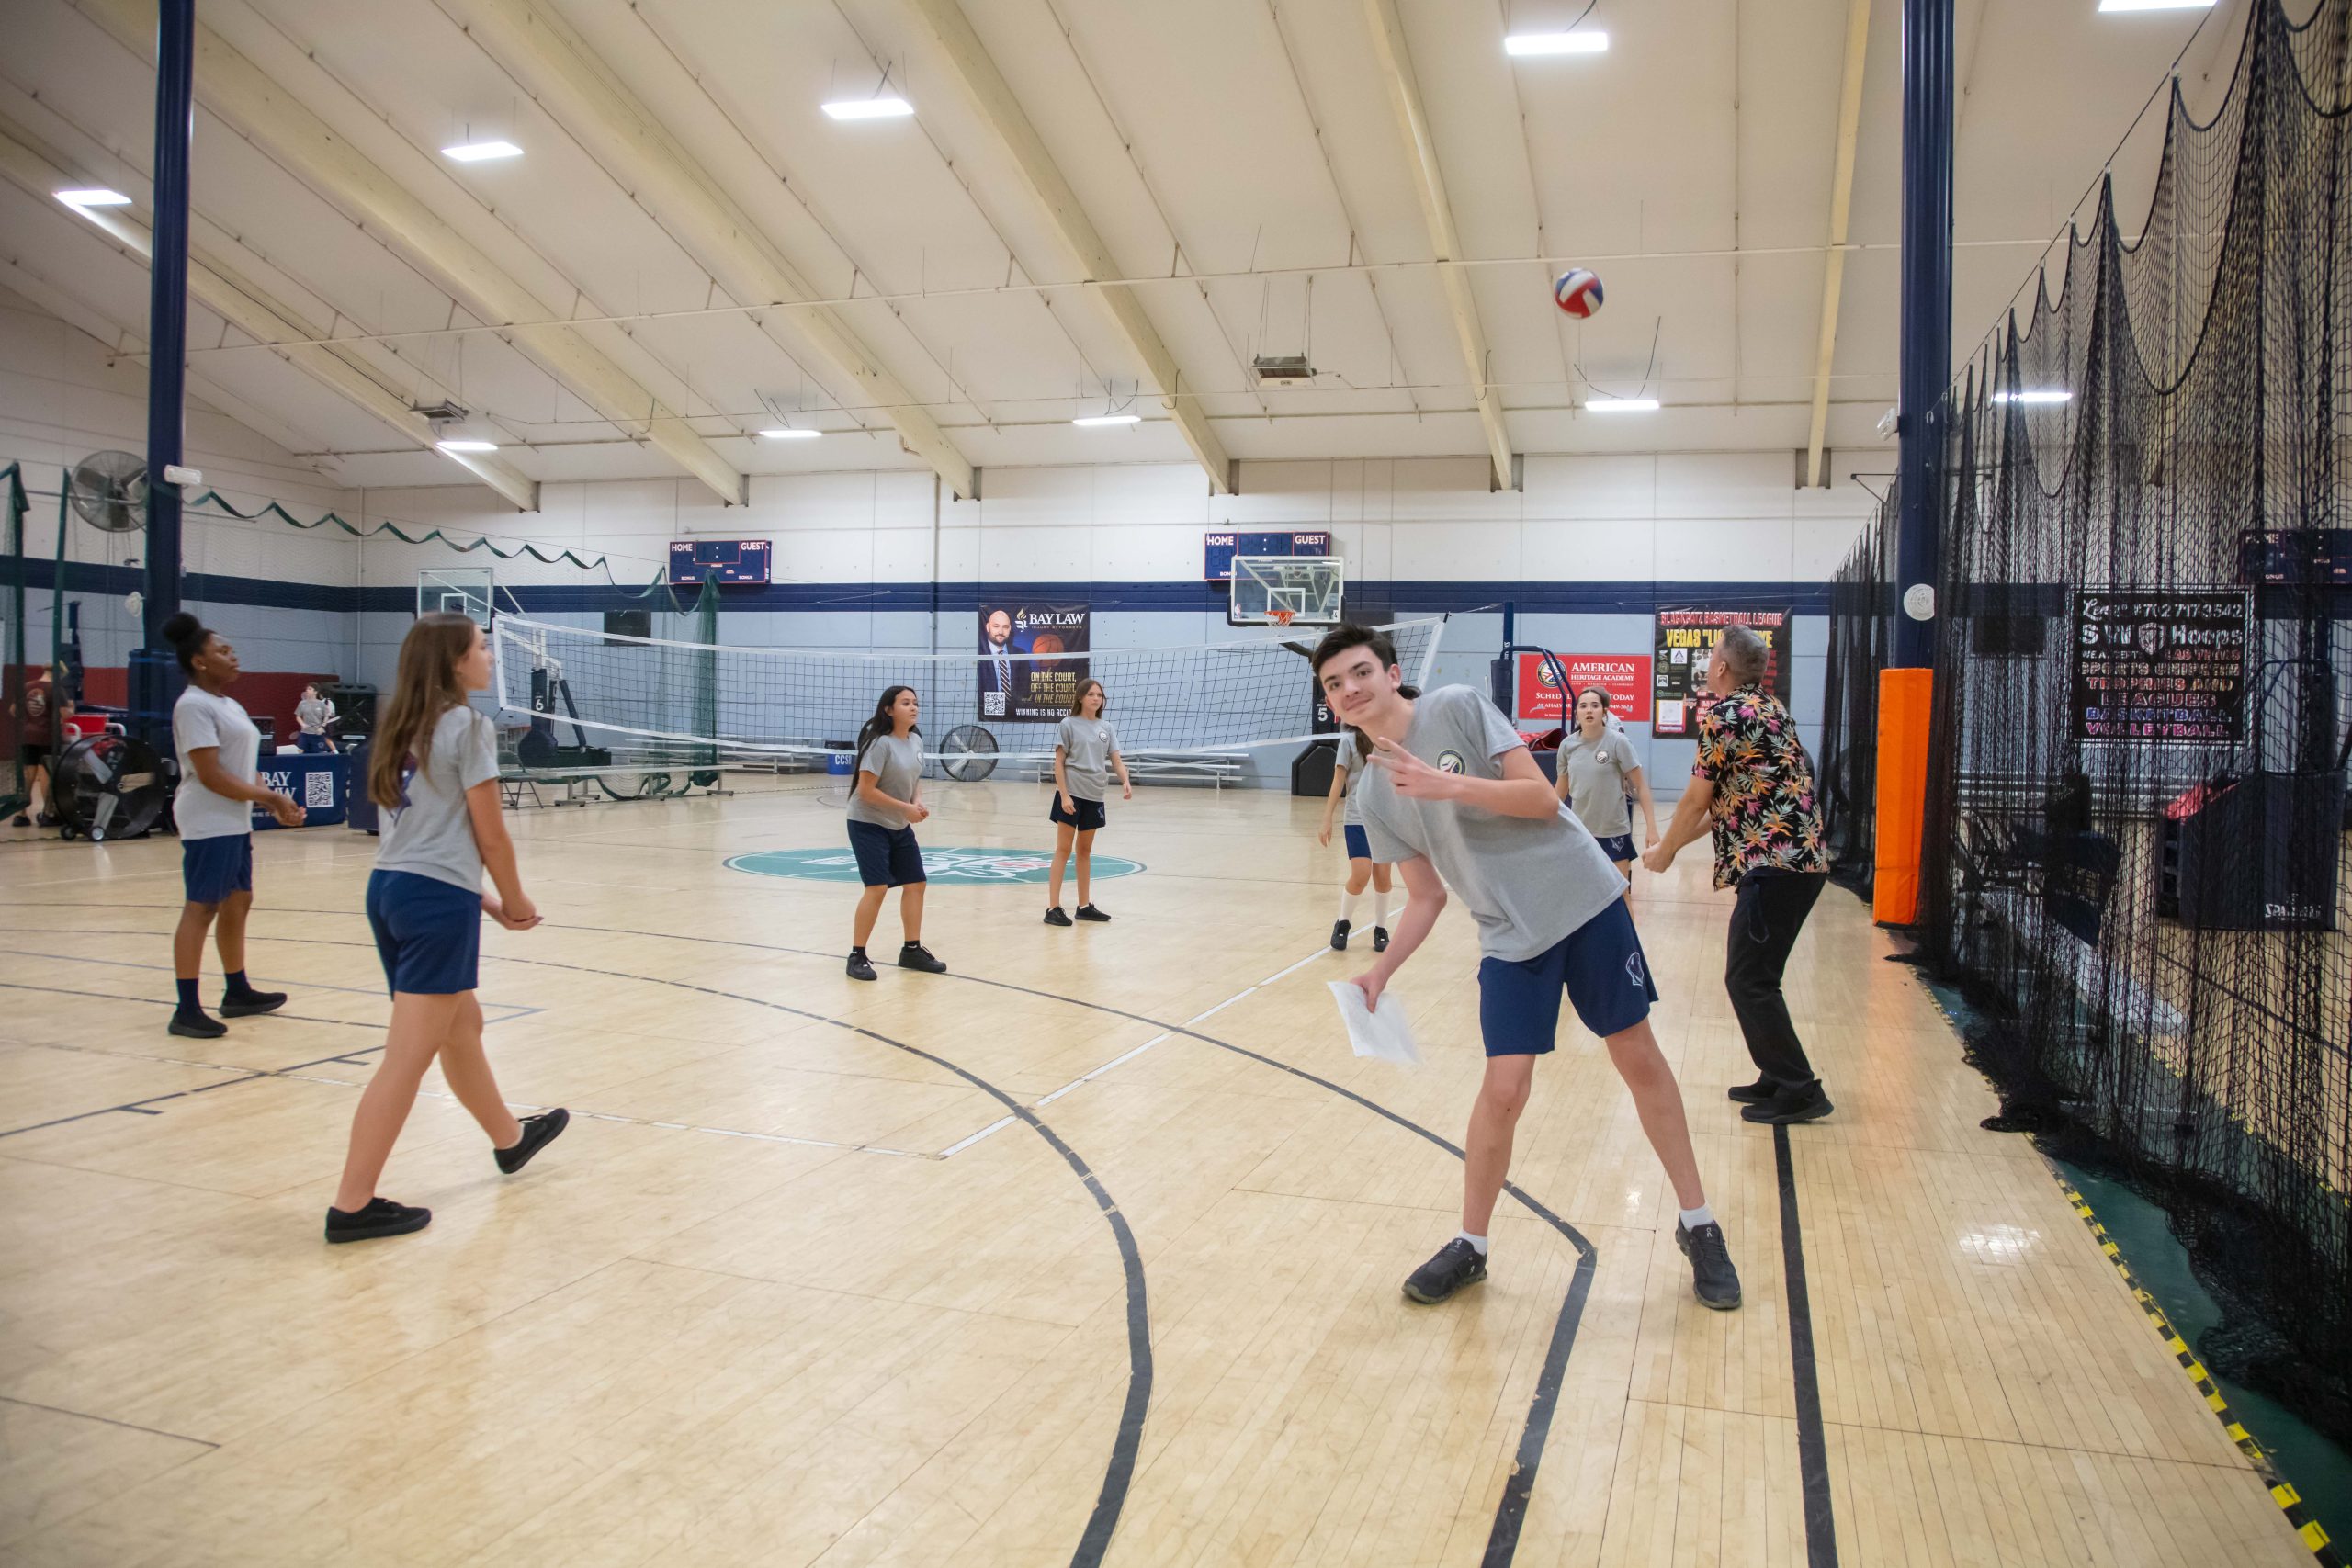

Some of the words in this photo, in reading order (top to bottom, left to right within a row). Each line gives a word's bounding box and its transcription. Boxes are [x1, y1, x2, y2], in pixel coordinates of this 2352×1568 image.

[1206, 536, 1234, 546] HOME
[1295, 535, 1326, 545] GUEST
[672, 543, 693, 552] HOME
[741, 542, 765, 550] GUEST
[1029, 613, 1054, 625] BAY
[1056, 613, 1085, 625] LAW
[1704, 611, 1752, 626] BASKETBALL
[1752, 612, 1782, 626] LEAGUE
[1666, 628, 1701, 648] VEGAS
[2171, 624, 2243, 649] Hoops
[1570, 662, 1634, 672] AMERICAN
[1030, 671, 1040, 682] ON
[1042, 671, 1053, 682] THE
[1054, 671, 1077, 682] COURT,
[1030, 682, 1041, 693] OFF
[1043, 682, 1054, 693] THE
[1043, 694, 1054, 704] THE
[2100, 692, 2217, 706] LEAGUES
[536, 699, 544, 711] 6
[1015, 708, 1039, 716] WINNING
[1039, 708, 1046, 716] IS
[1046, 708, 1055, 716] NO
[1317, 707, 1329, 722] 5
[2086, 707, 2233, 722] BASKETBALL
[260, 771, 292, 787] BAY
